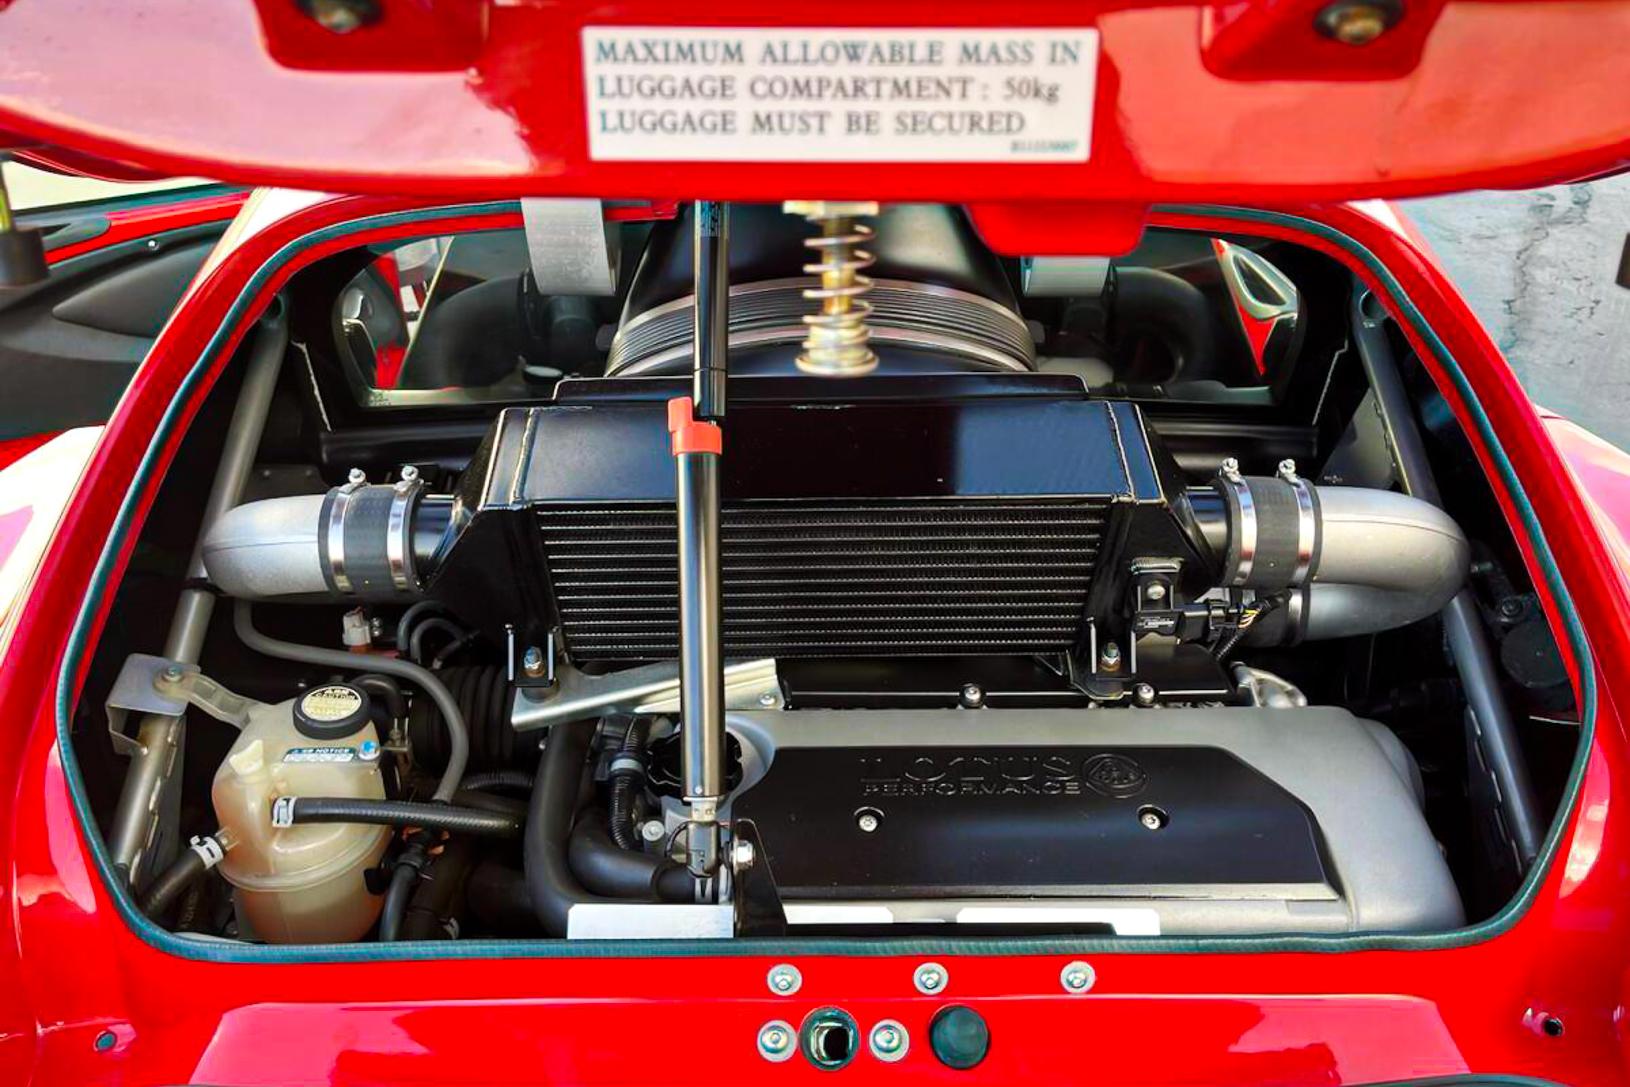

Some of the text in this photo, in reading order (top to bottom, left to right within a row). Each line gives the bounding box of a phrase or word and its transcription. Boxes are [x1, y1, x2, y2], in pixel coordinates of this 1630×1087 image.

[595, 40, 1082, 65] MAXIMUM ALLOWABLE MASS IN
[597, 74, 737, 100] LUGGAGE
[1003, 76, 1061, 105] 50kg
[599, 109, 1026, 135] LUGGAGE MUST BE SECURED
[859, 756, 1076, 782] LOTUS
[862, 782, 1082, 797] PERFORMANCE
